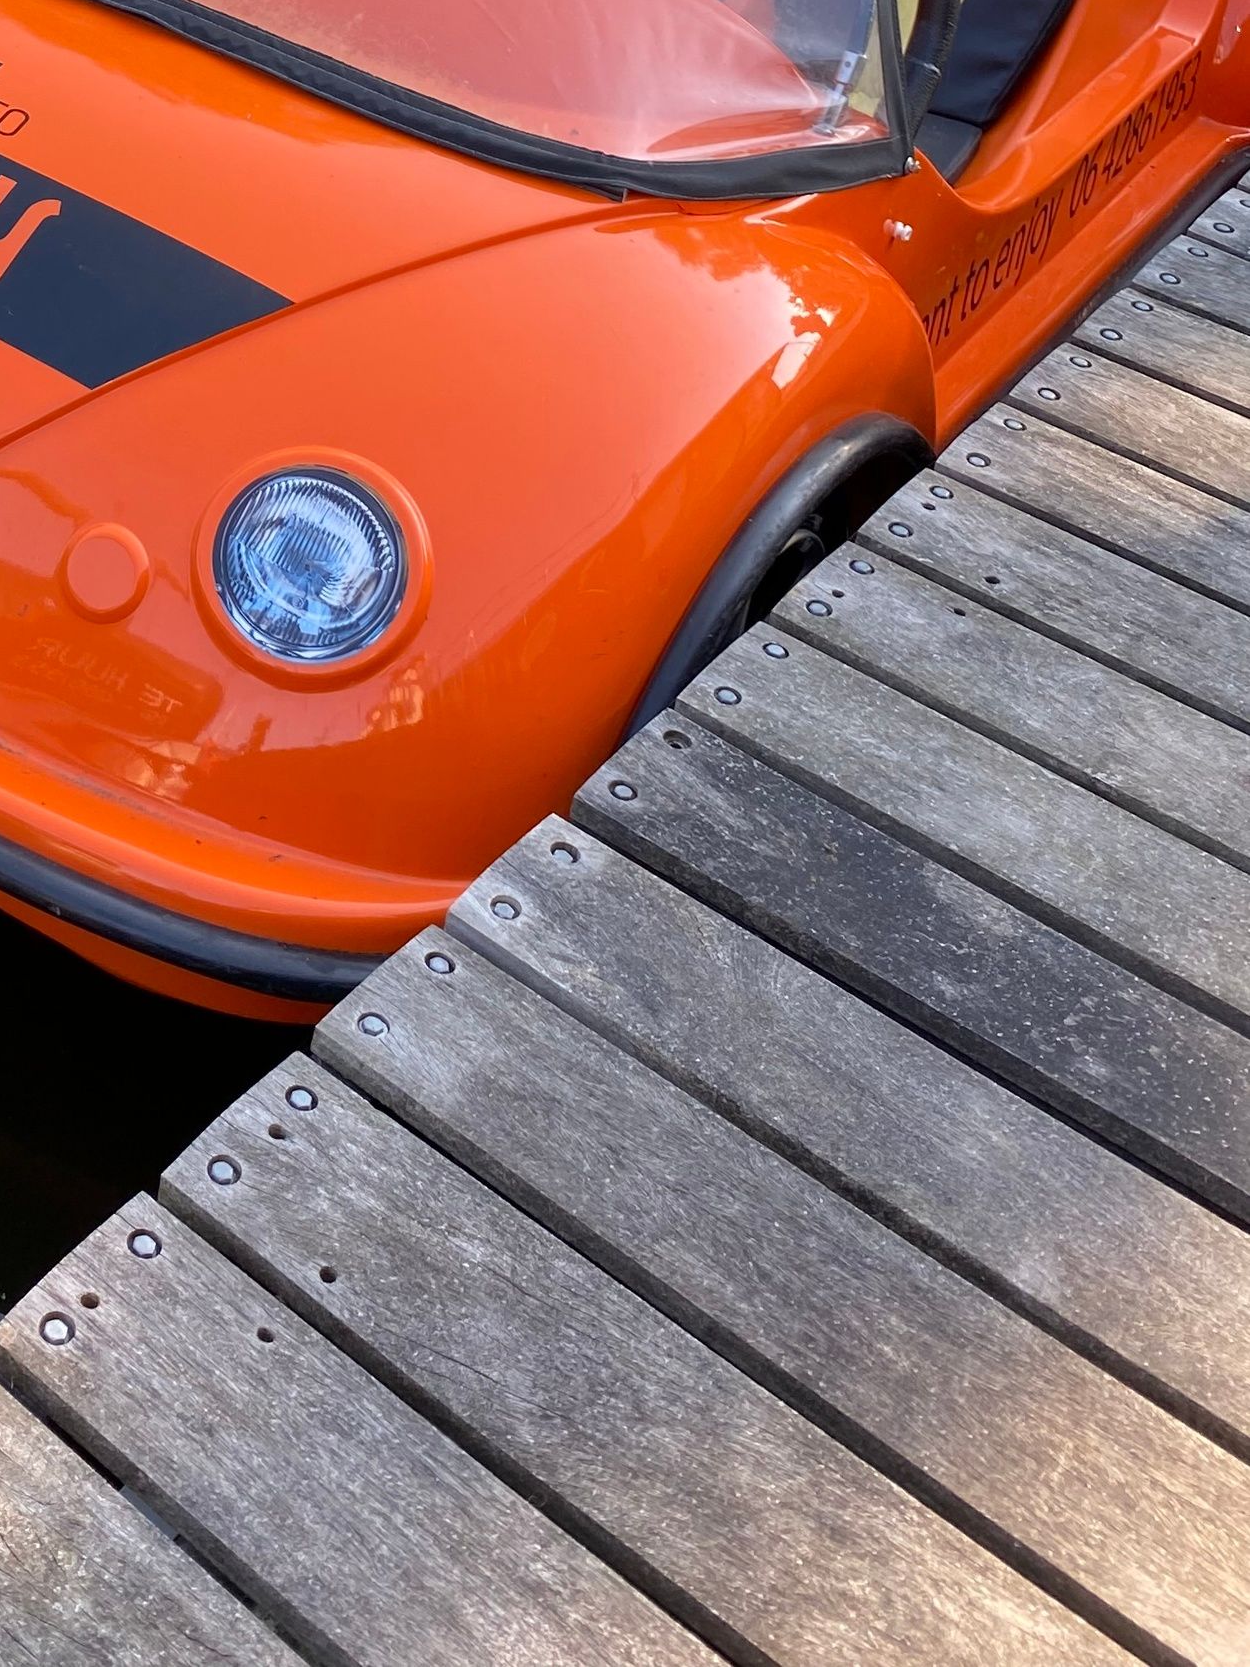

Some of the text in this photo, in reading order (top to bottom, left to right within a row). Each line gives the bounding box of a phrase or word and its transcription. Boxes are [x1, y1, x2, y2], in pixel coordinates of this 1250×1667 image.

[961, 259, 990, 322] to
[993, 188, 1064, 289] enjoy
[1069, 140, 1103, 218] 06
